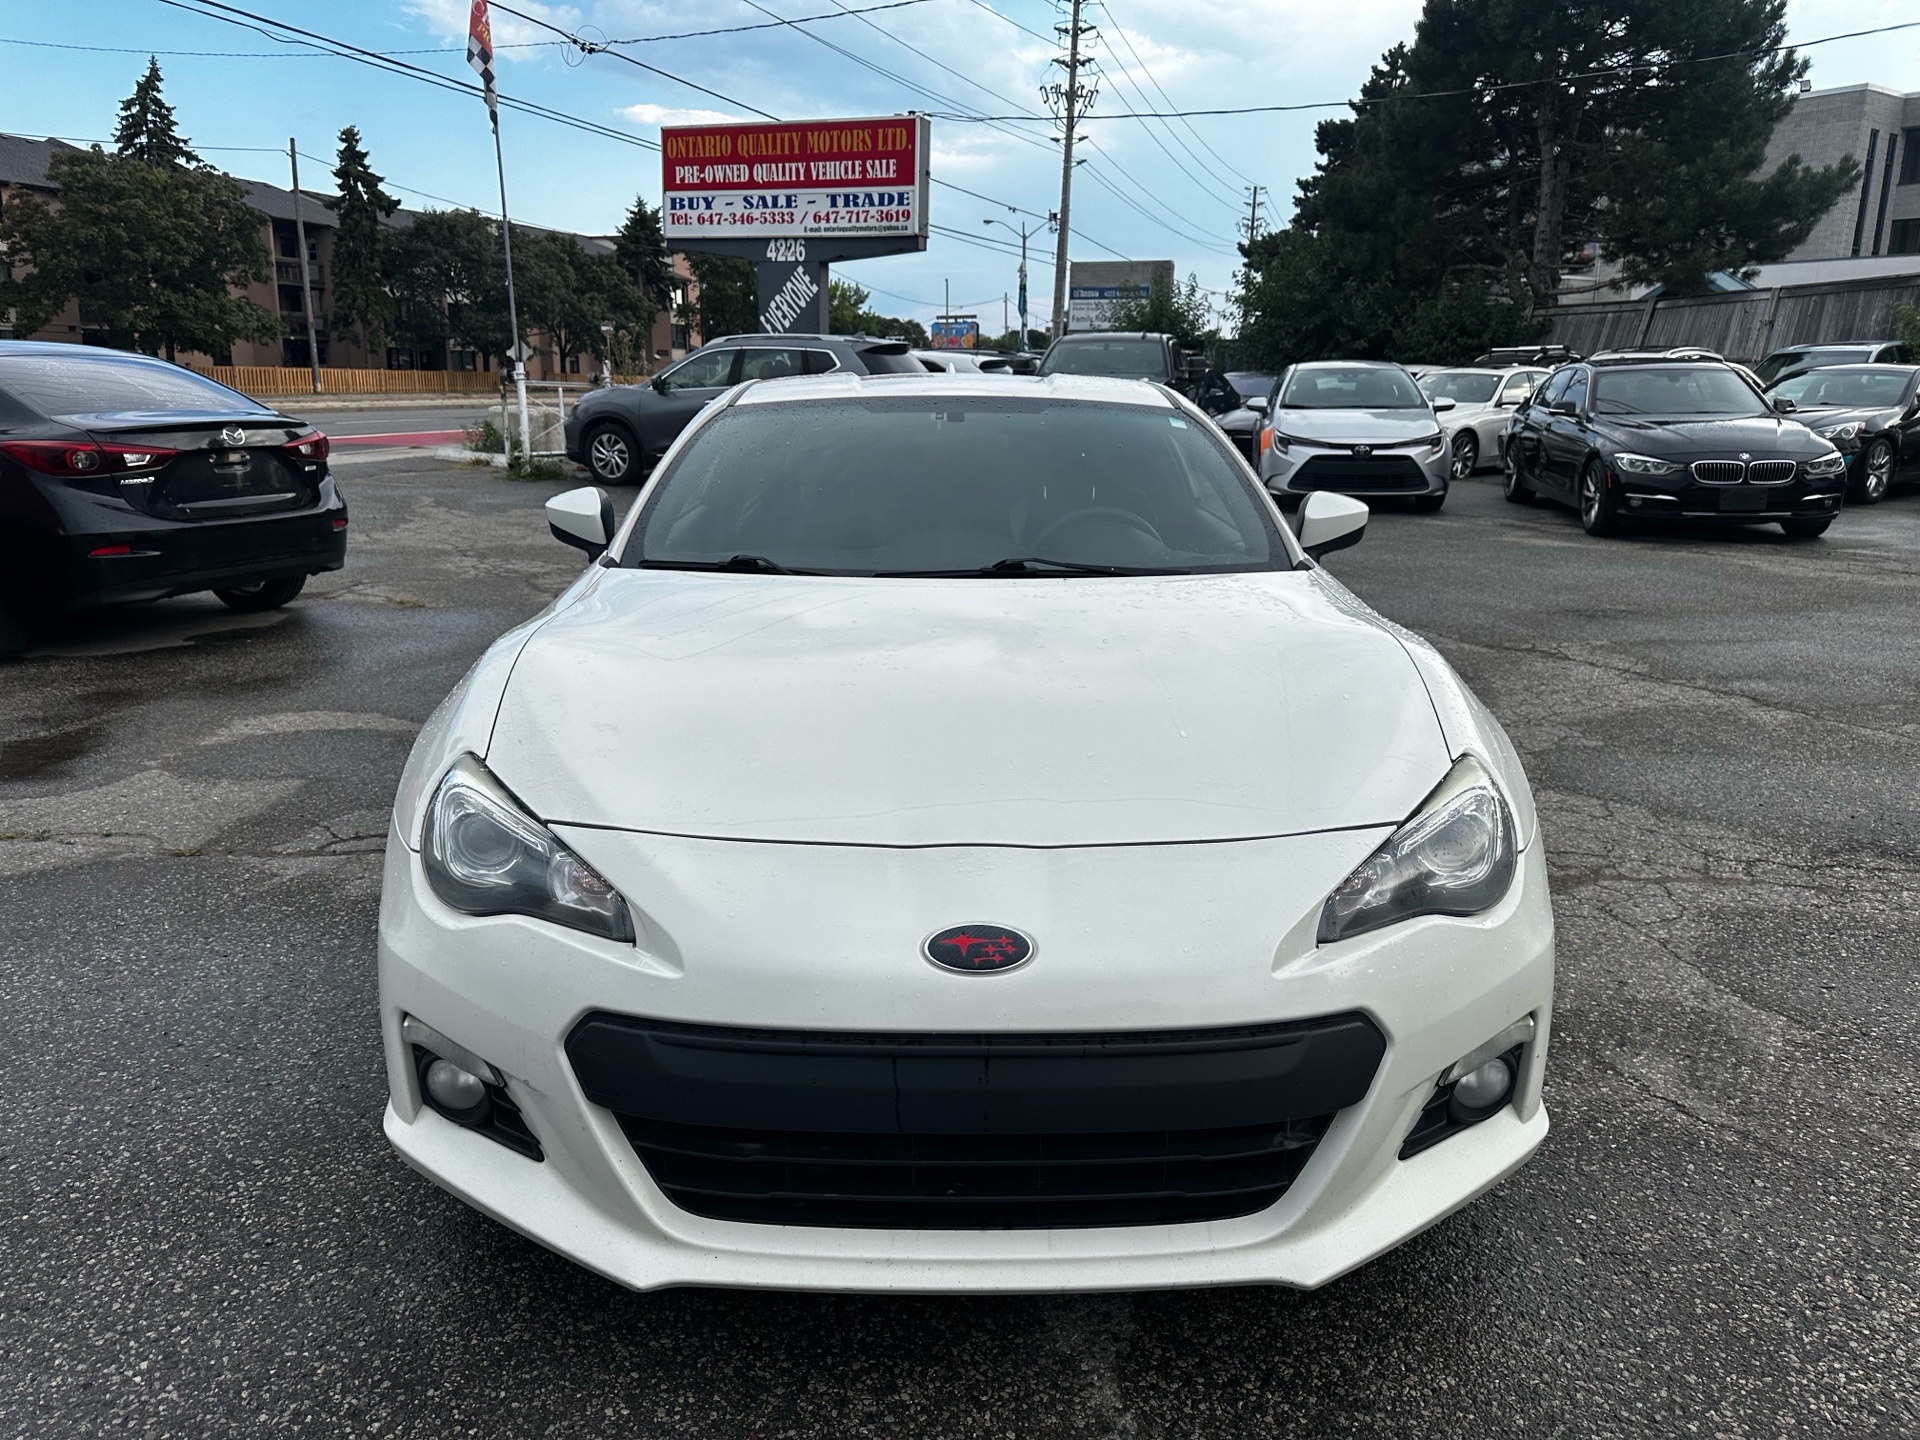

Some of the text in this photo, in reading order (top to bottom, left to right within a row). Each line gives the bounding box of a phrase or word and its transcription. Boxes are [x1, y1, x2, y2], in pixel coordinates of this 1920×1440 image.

[667, 127, 912, 159] ONTARIO QUALITY MOTORS LTD.
[675, 158, 897, 184] PRE-OWNED QUALITY VEHICLE SALE
[669, 196, 716, 210] BUY
[742, 194, 798, 210] SALE
[826, 191, 910, 208] TRADE
[669, 209, 911, 226] Tel: 647-346-5333 / 647-717-3619
[804, 224, 909, 233] E-mail: ontarioqualitymotors@yahoo.ca
[766, 239, 806, 262] 4226
[760, 265, 819, 335] EVERYONE
